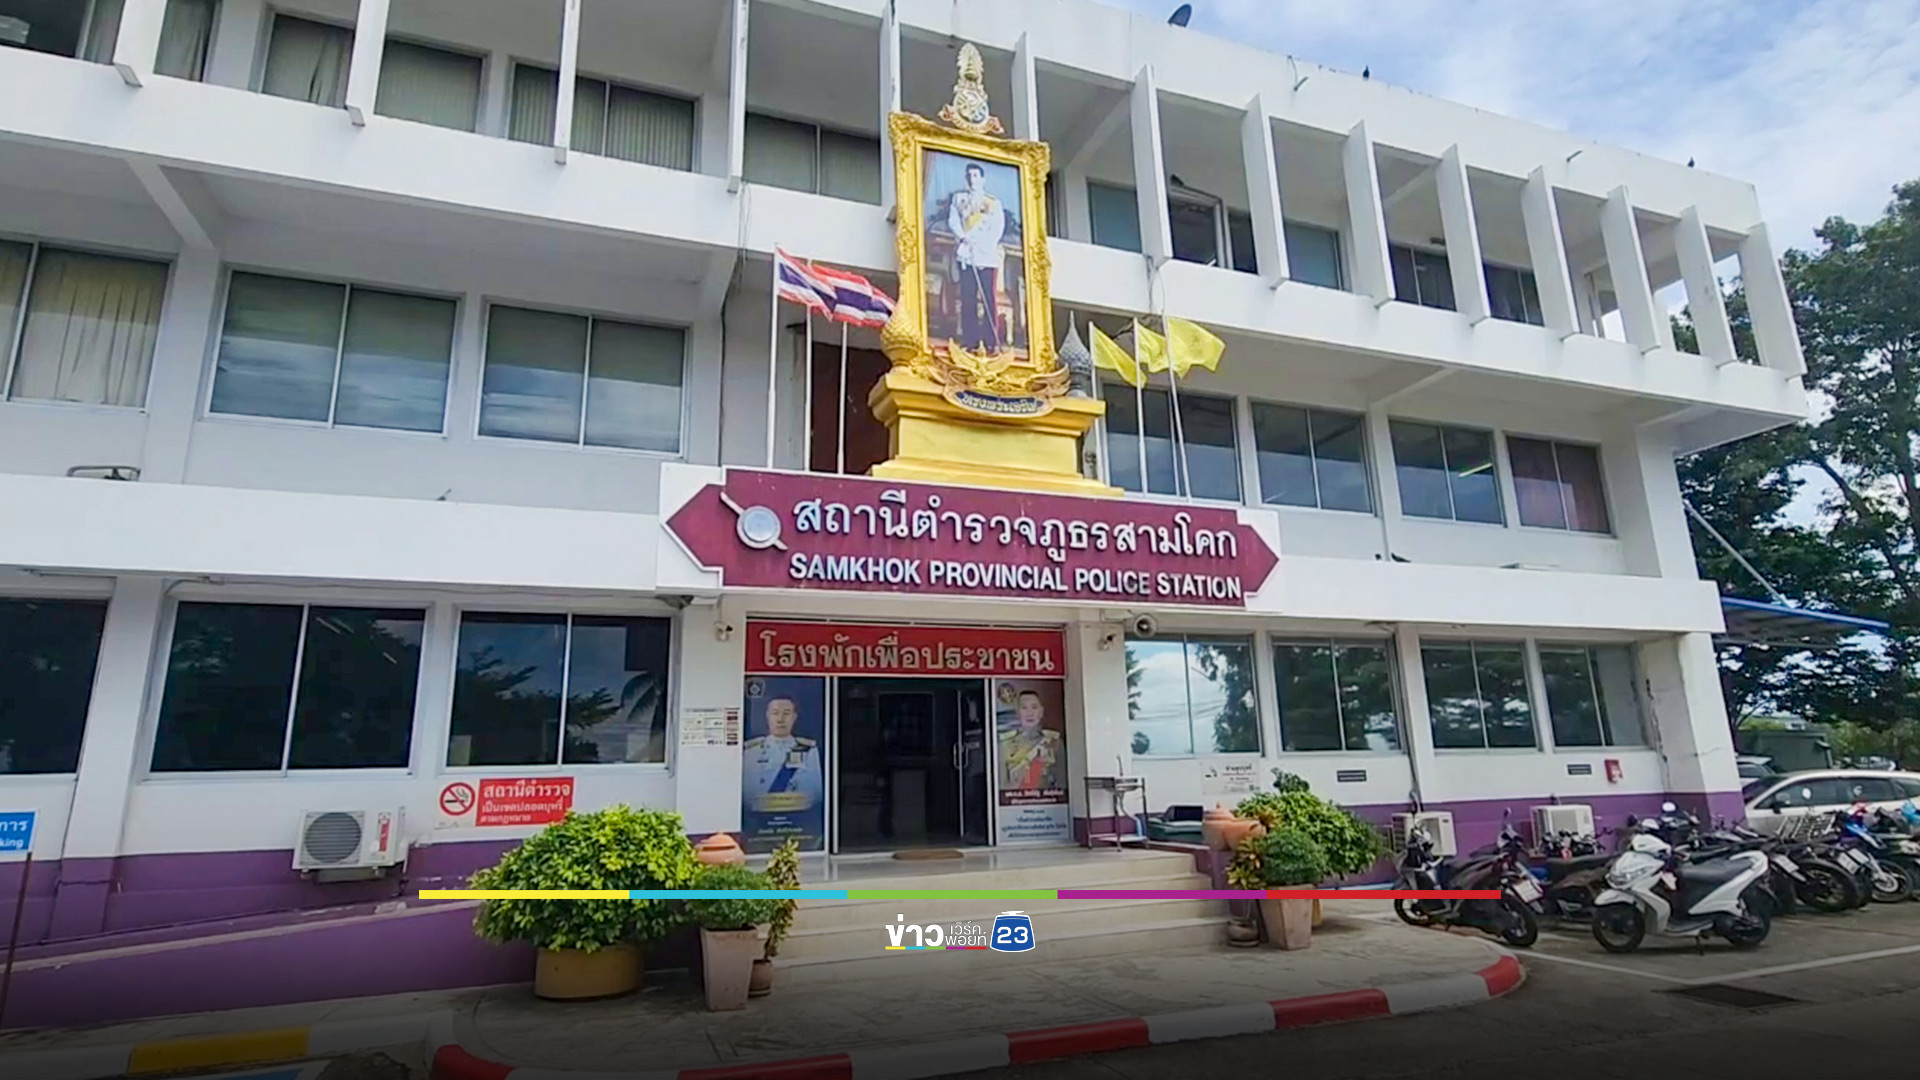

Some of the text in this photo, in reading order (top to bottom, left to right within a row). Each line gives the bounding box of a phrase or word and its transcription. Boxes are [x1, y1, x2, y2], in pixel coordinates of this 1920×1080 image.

[793, 489, 1237, 562] สถานีตำรวจภูธรสามโคก
[789, 552, 1242, 599] SAMKHOK PROVINCIAL POLICE STATION
[759, 629, 1056, 672] โรงพักเพื่อประชาชน
[483, 780, 570, 799] สถานีตำรวจ
